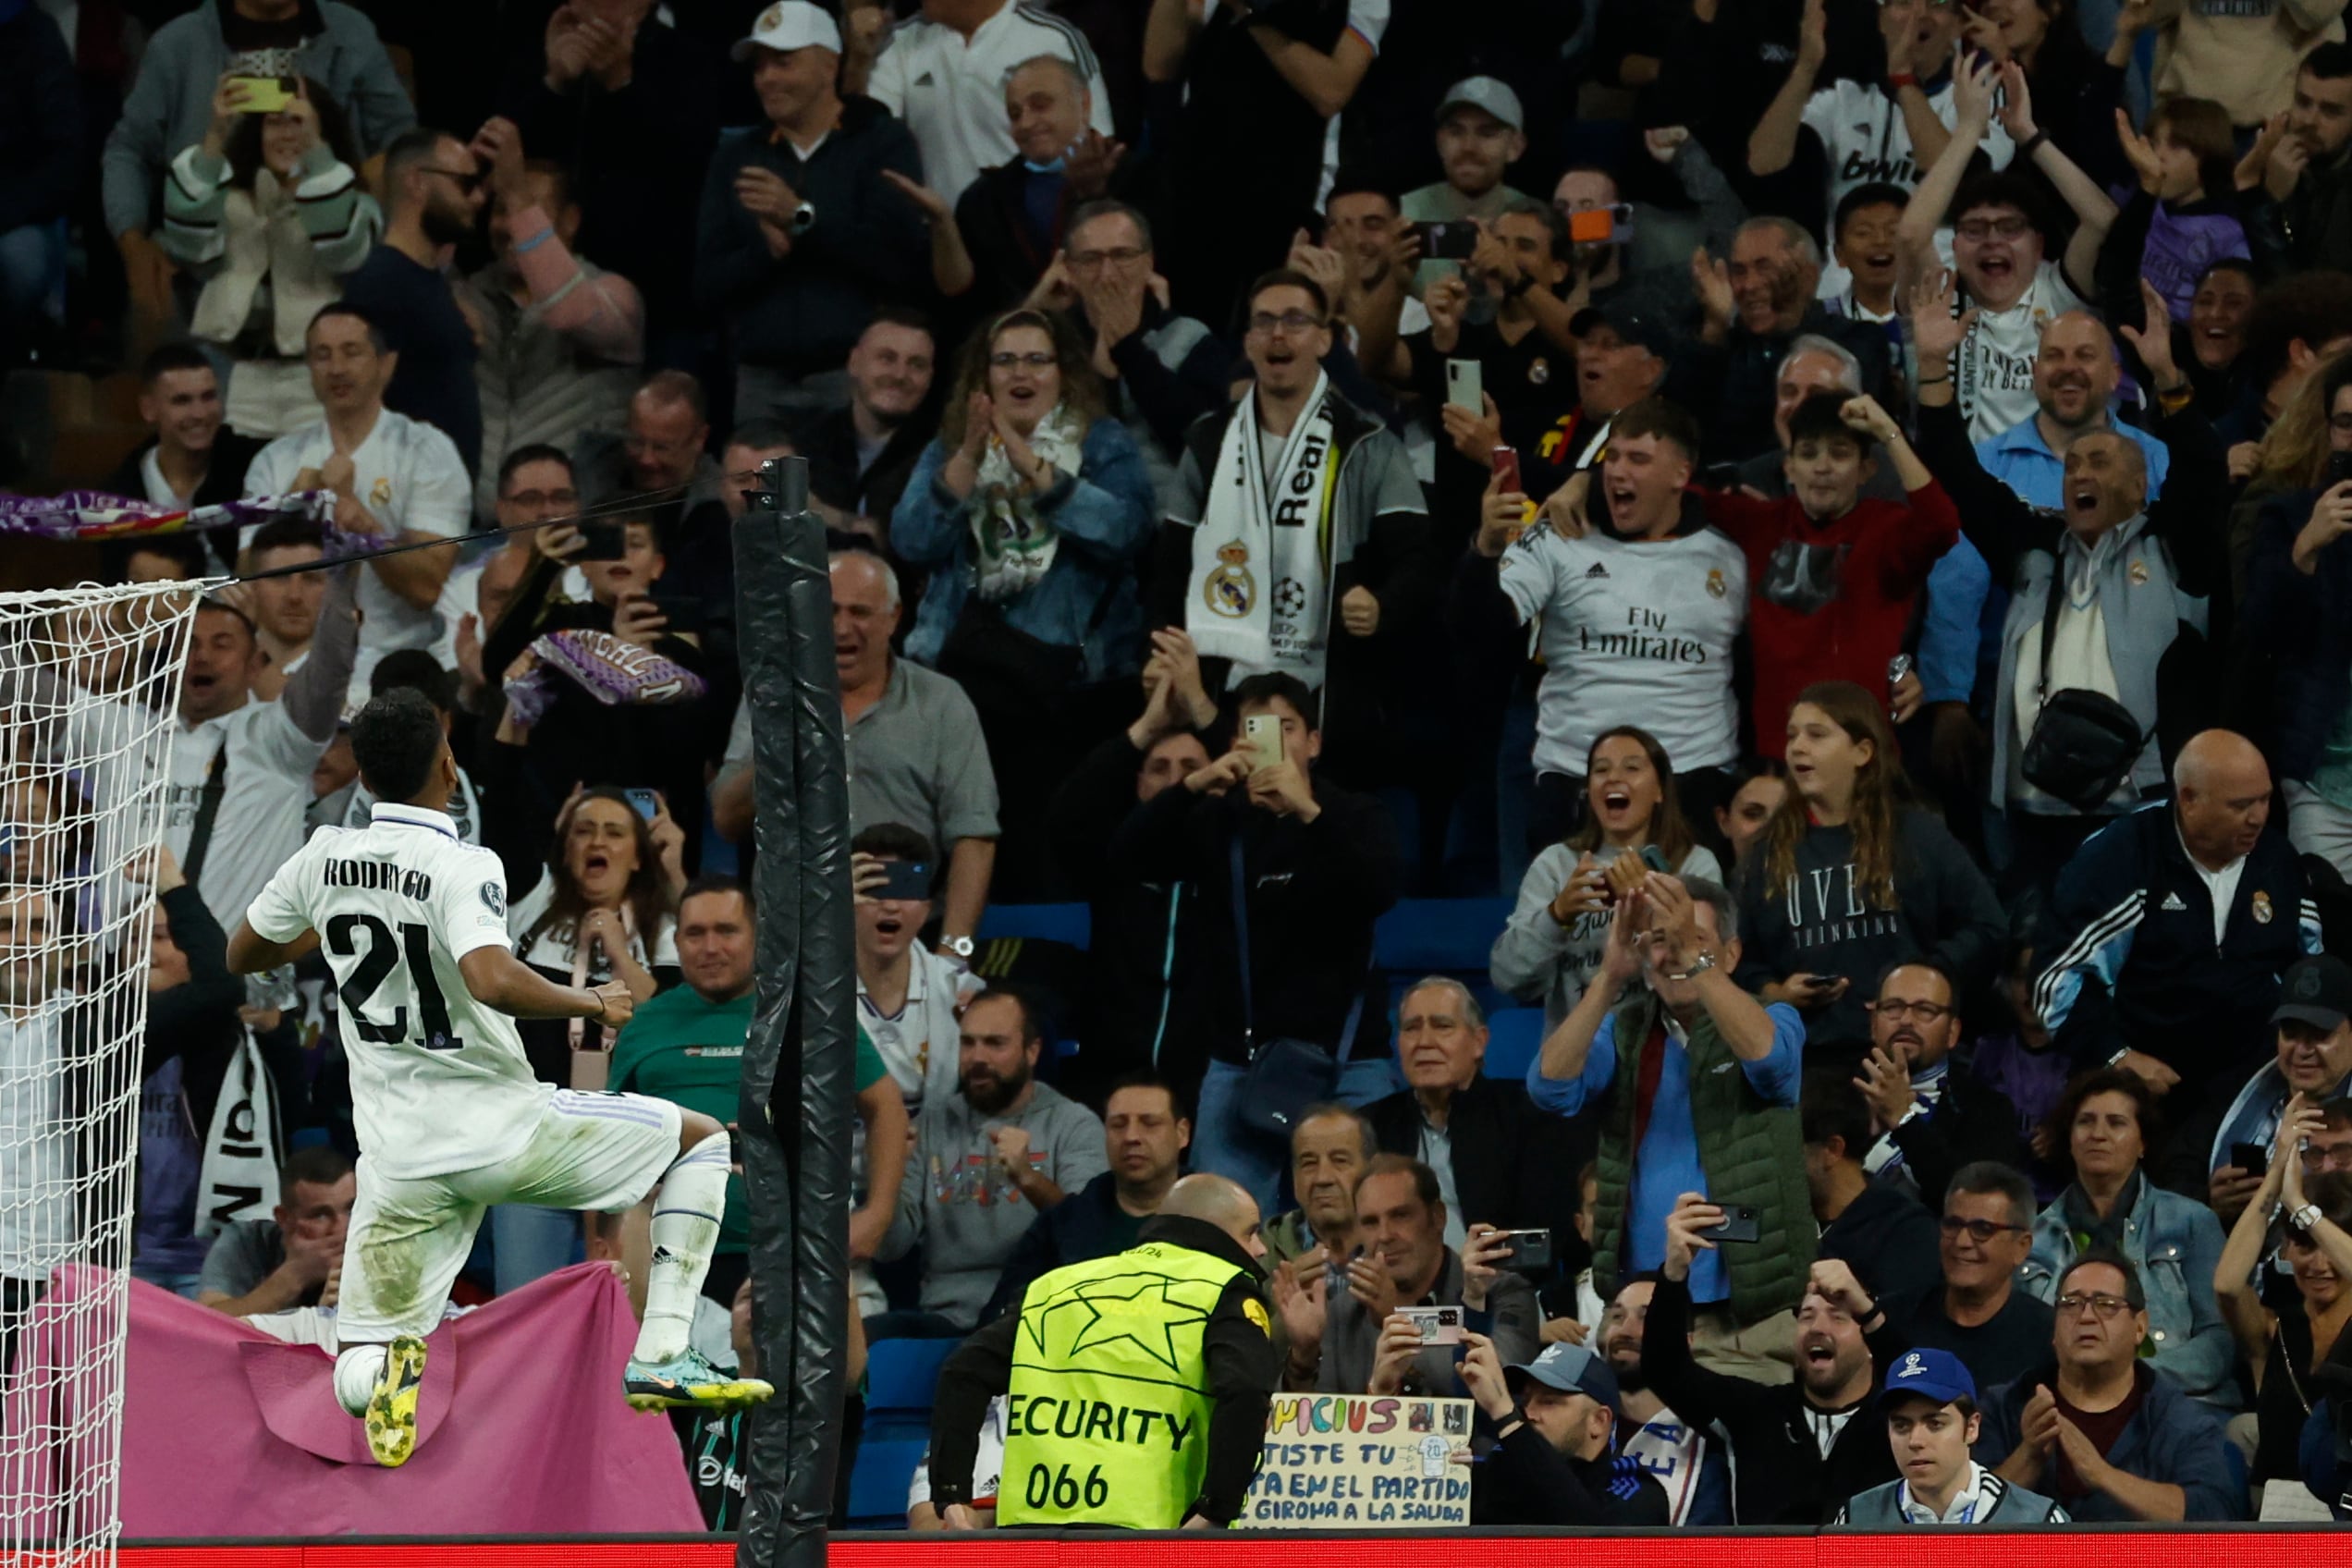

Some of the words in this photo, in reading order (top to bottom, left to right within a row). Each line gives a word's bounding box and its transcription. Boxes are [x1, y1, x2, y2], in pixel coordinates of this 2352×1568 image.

[1275, 434, 1327, 527] Real
[1628, 606, 1667, 631] Fly
[1579, 627, 1706, 664] Emirates
[325, 858, 431, 901] RODRYGO
[326, 913, 463, 1050] 21
[1008, 1394, 1192, 1452] ECURITY
[1265, 1397, 1402, 1437] NICIUS
[1359, 1444, 1395, 1464] TU
[1026, 1464, 1108, 1509] 066
[1331, 1476, 1364, 1498] EL
[1372, 1476, 1469, 1501] PARTIDO
[1256, 1500, 1338, 1520] GIRONA
[1343, 1502, 1358, 1520] A
[1367, 1502, 1395, 1521] LA
